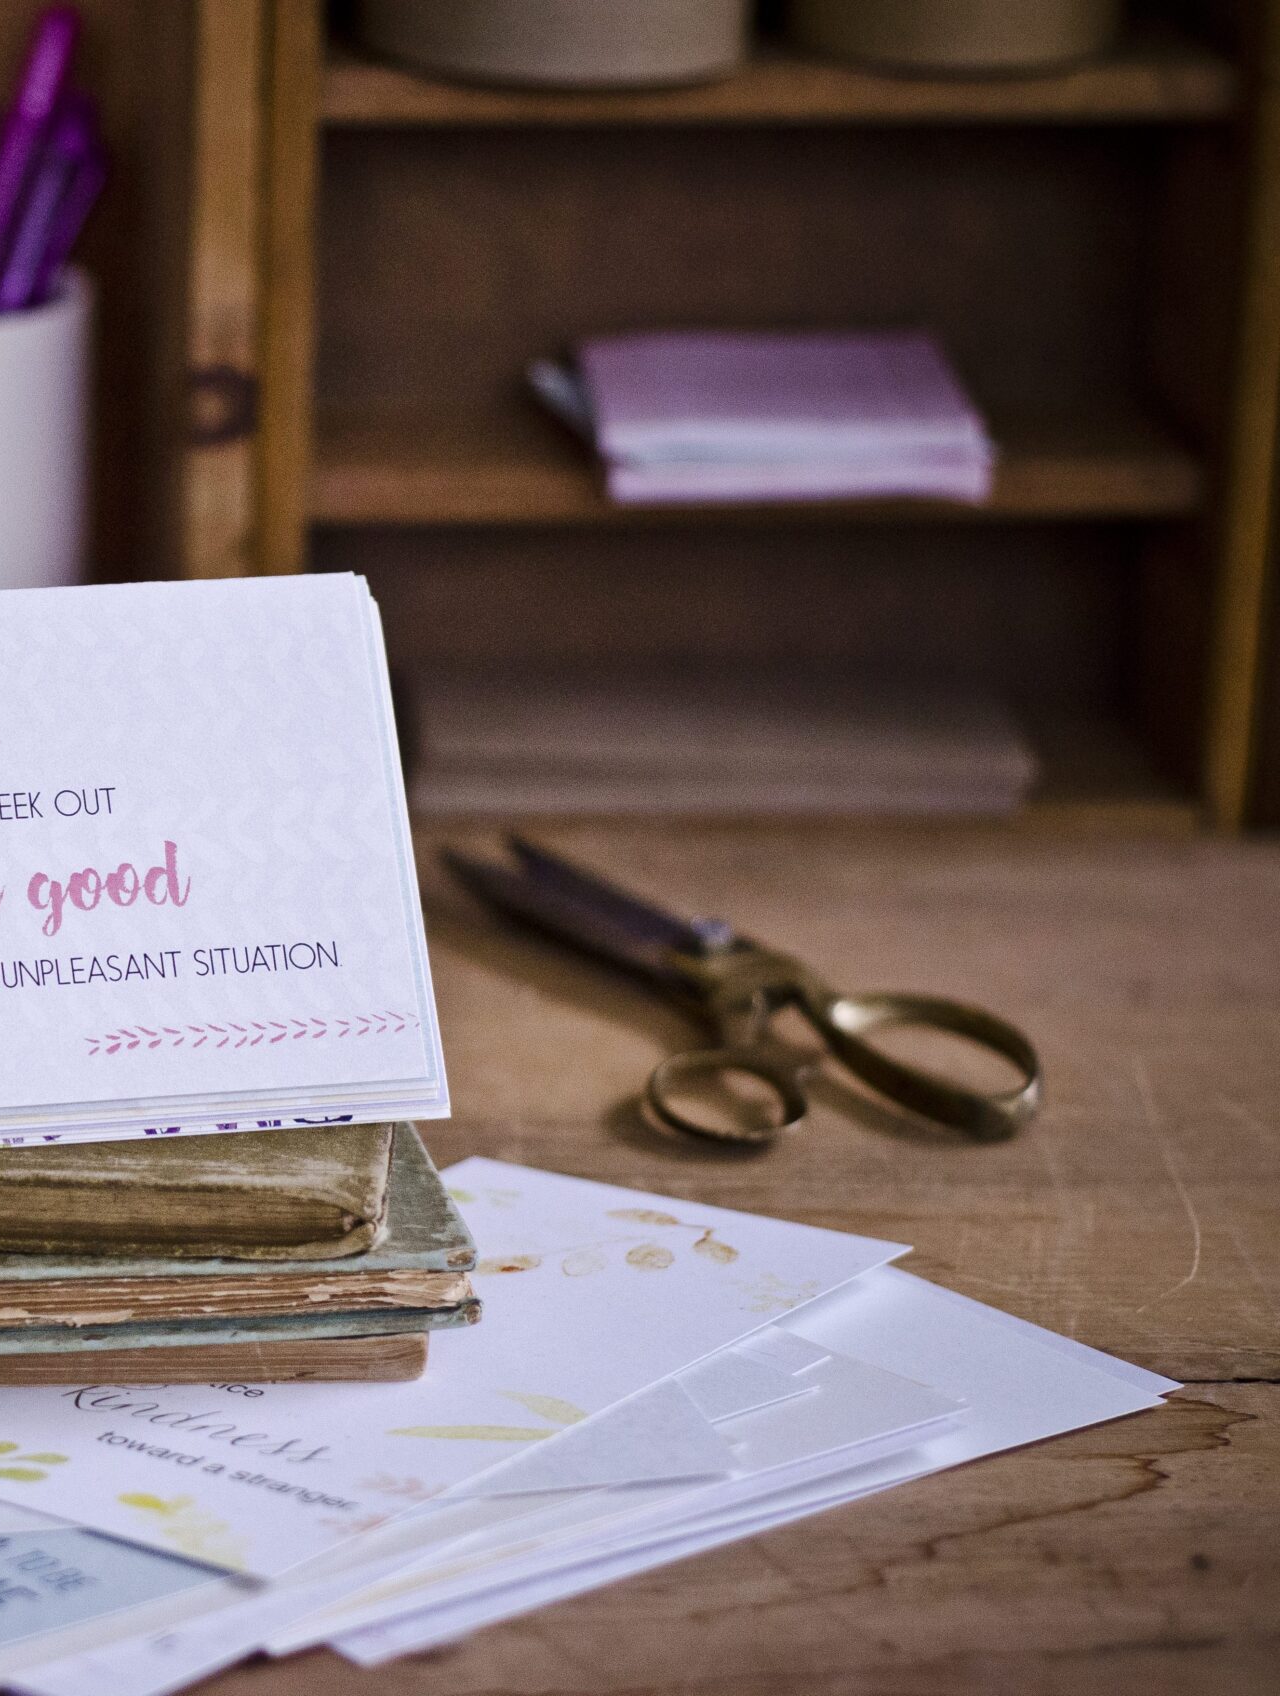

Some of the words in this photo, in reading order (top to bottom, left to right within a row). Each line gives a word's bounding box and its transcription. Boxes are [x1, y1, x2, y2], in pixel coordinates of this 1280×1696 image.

[54, 787, 116, 817] OUT
[27, 840, 191, 937] good
[1, 951, 181, 988] UNPLEASANT
[96, 1430, 205, 1466] toward
[202, 1463, 226, 1475] a
[229, 1469, 363, 1512] stranger
